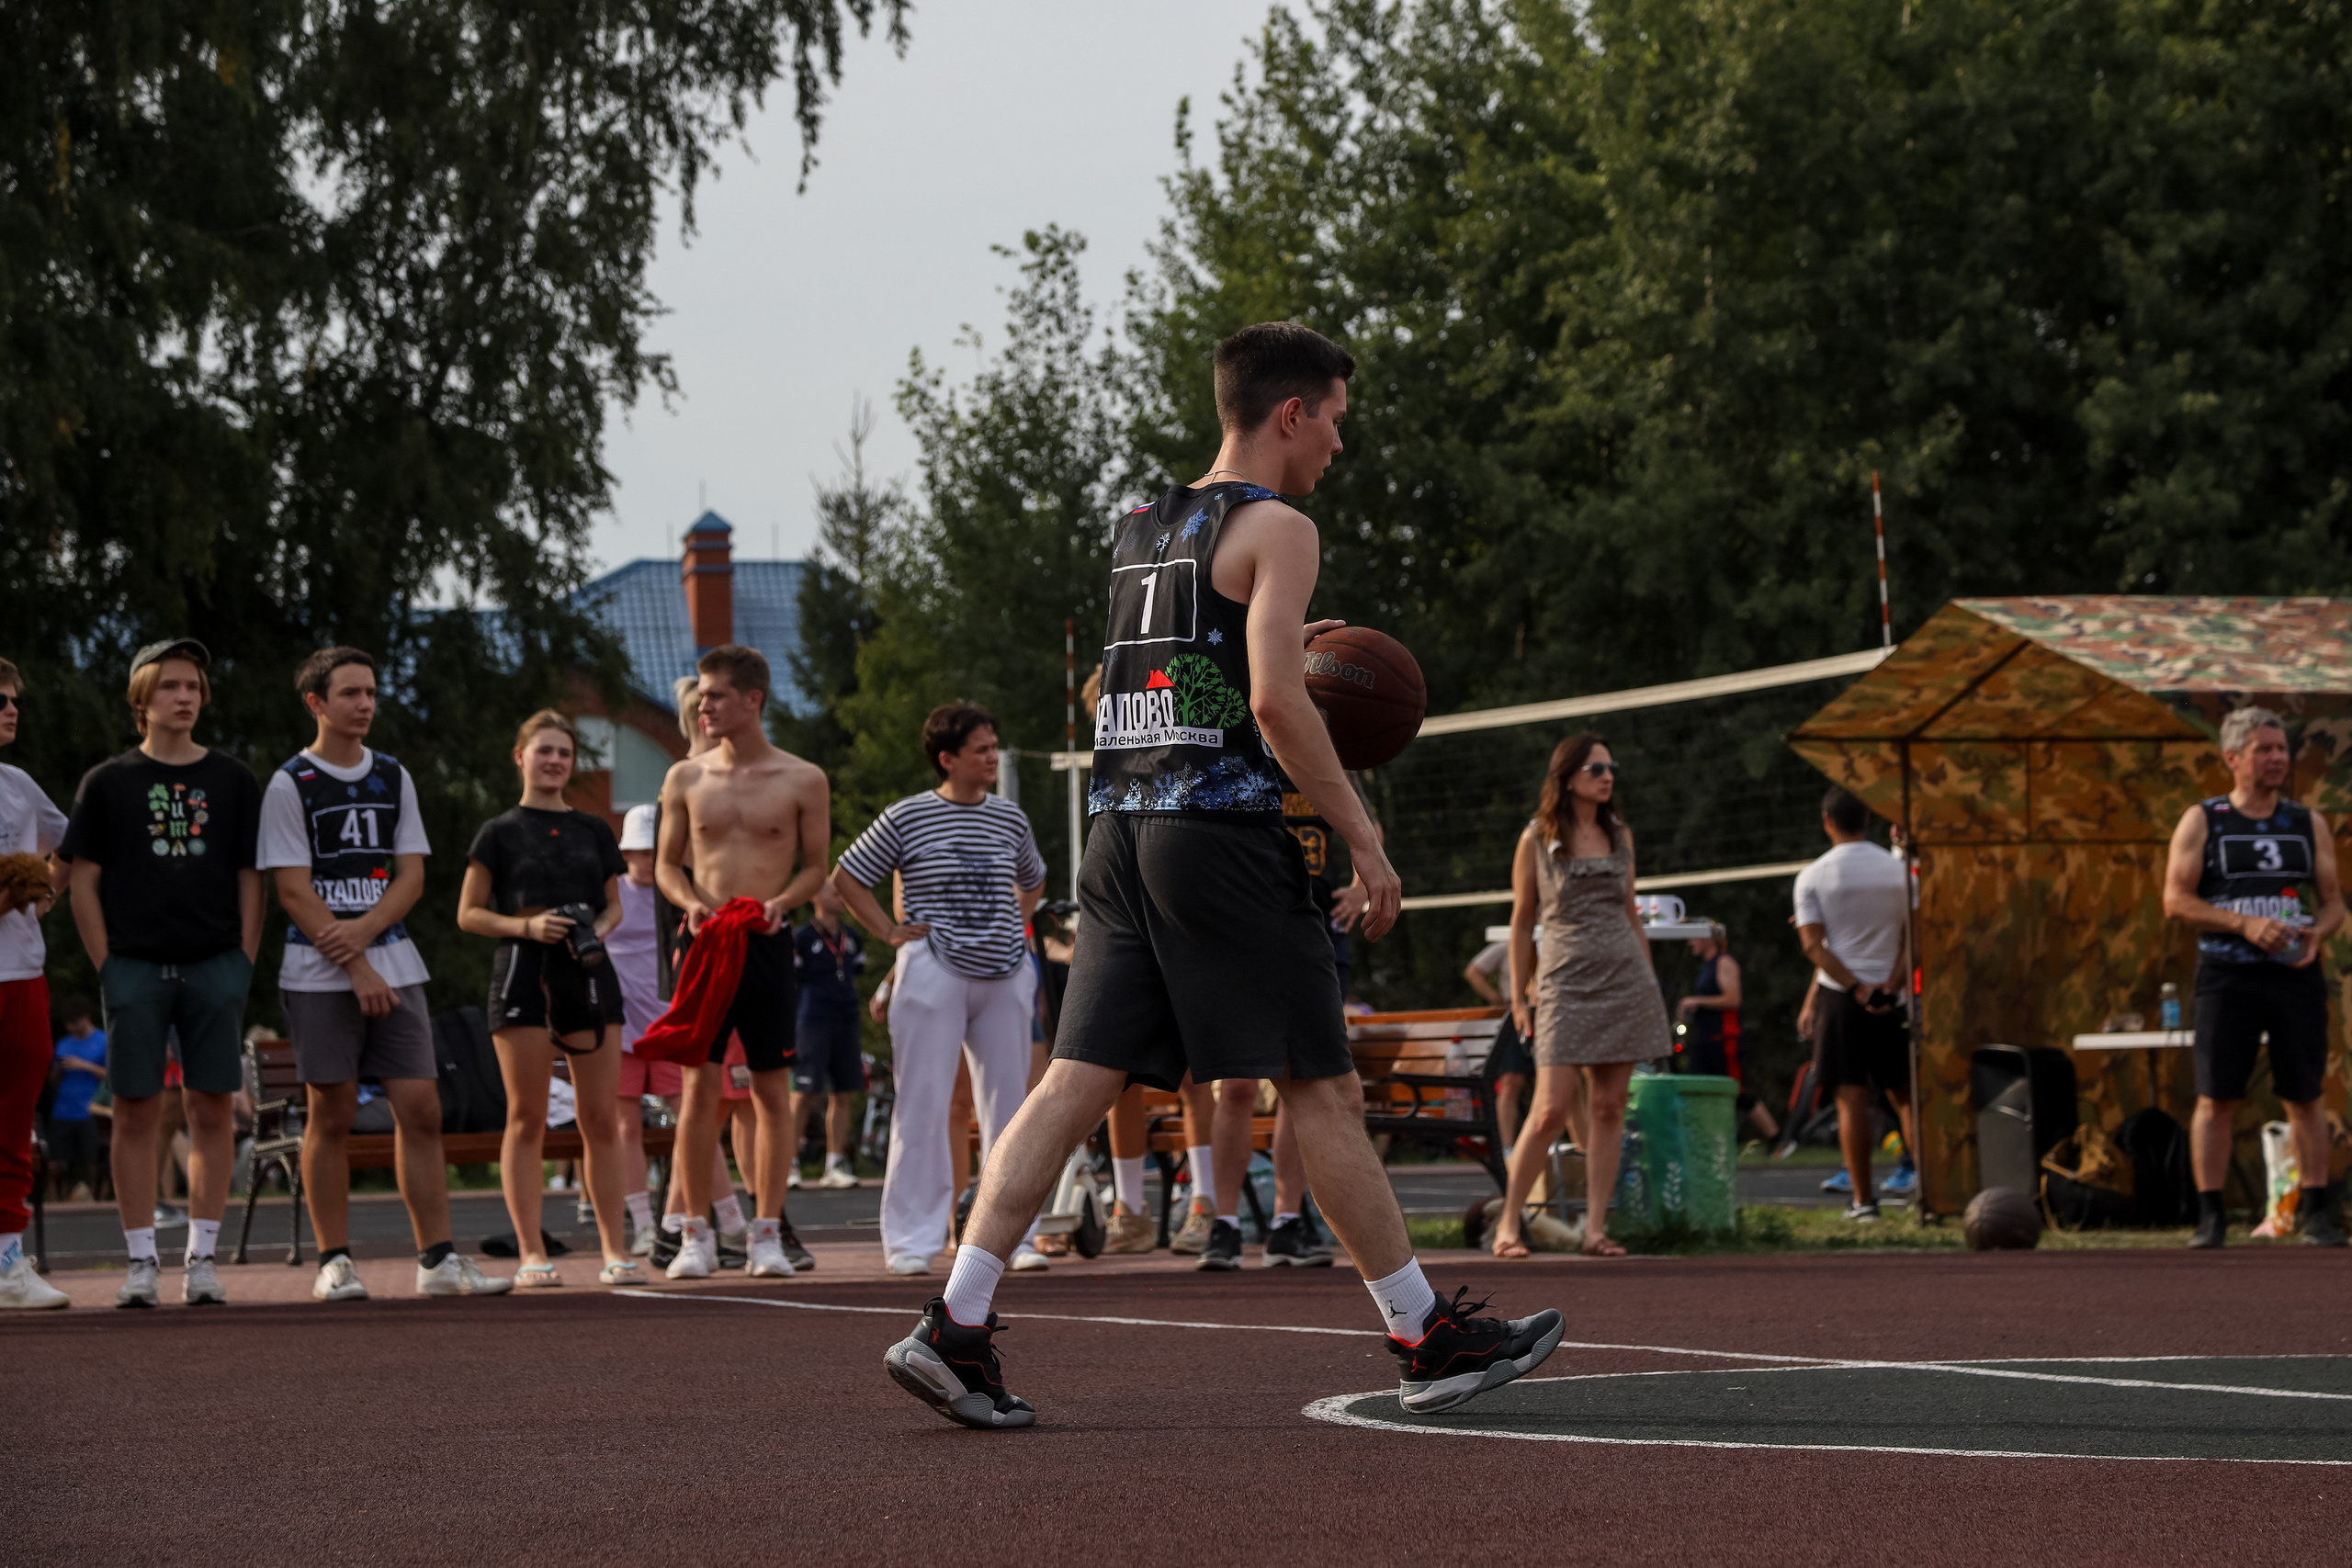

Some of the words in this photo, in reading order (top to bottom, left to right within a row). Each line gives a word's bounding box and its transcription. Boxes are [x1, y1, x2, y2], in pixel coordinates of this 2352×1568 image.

[1140, 571, 1158, 635] 1
[1164, 728, 1218, 744] Москва
[340, 808, 379, 847] 41
[2253, 838, 2283, 871] 3
